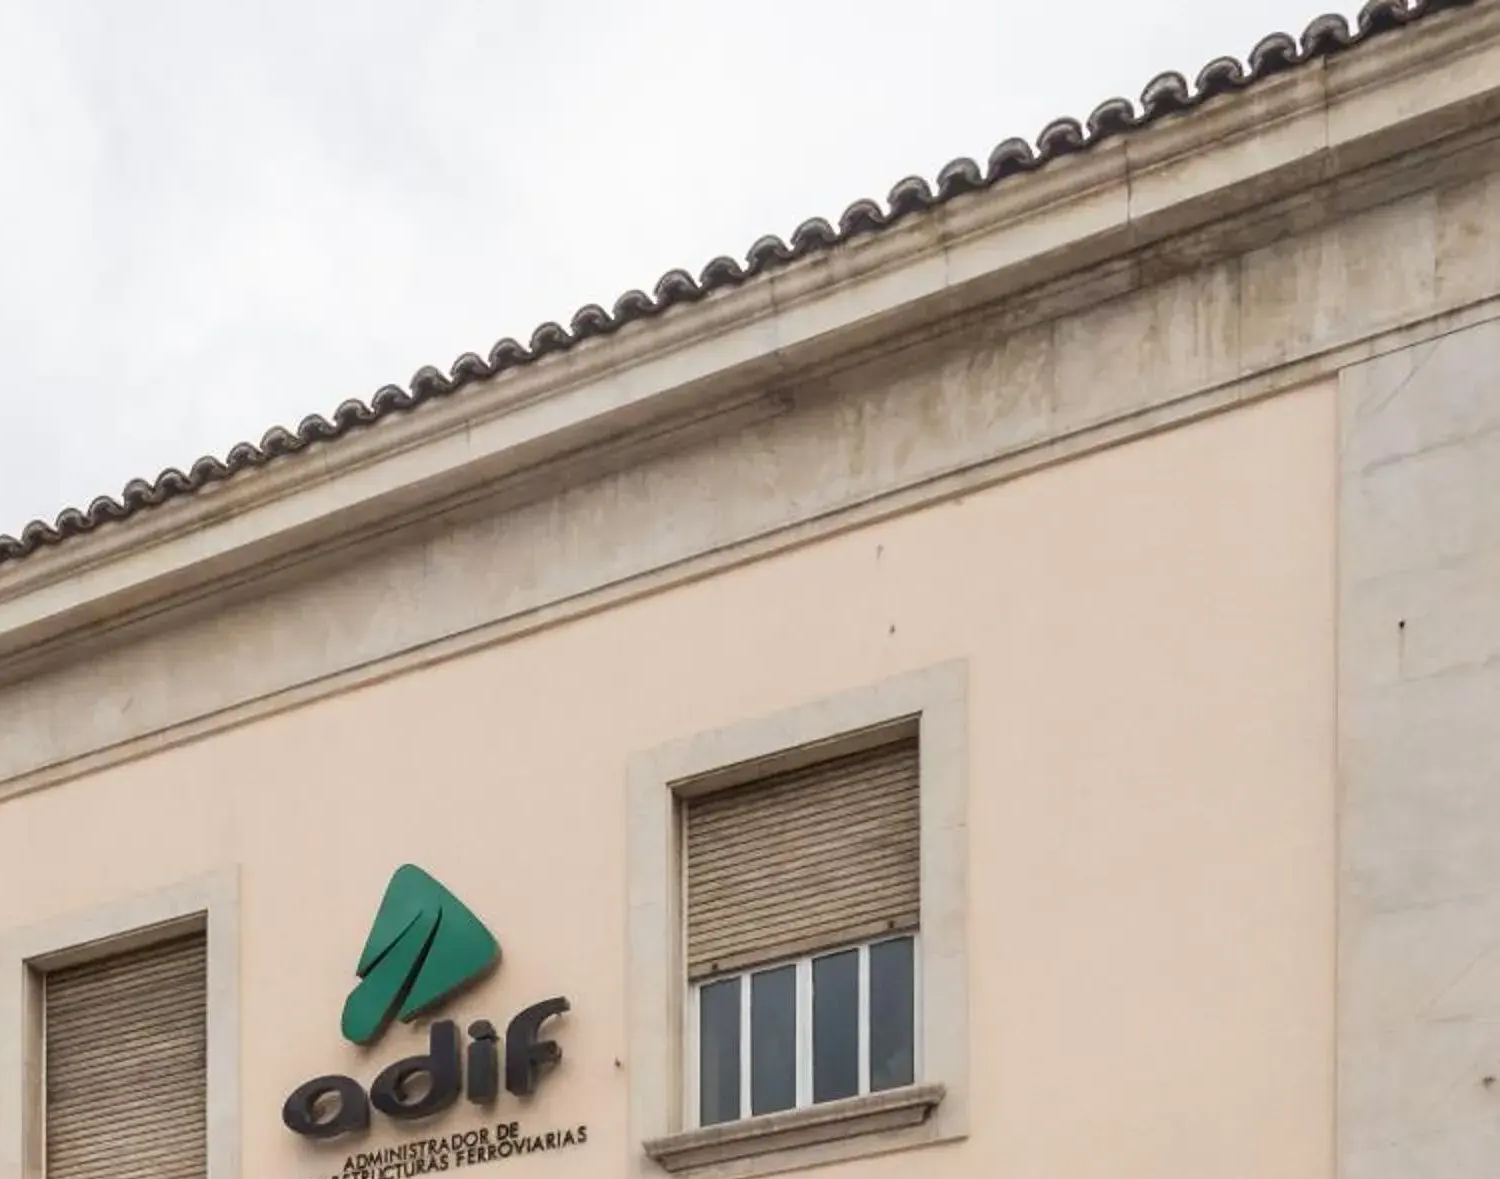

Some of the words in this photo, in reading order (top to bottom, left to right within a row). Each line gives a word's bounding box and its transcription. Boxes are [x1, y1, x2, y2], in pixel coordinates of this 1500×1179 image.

[282, 996, 570, 1140] adif
[344, 1128, 489, 1172] ADMINISTRADOR
[497, 1122, 519, 1141] DE
[456, 1126, 588, 1167] FERROVIARIAS
